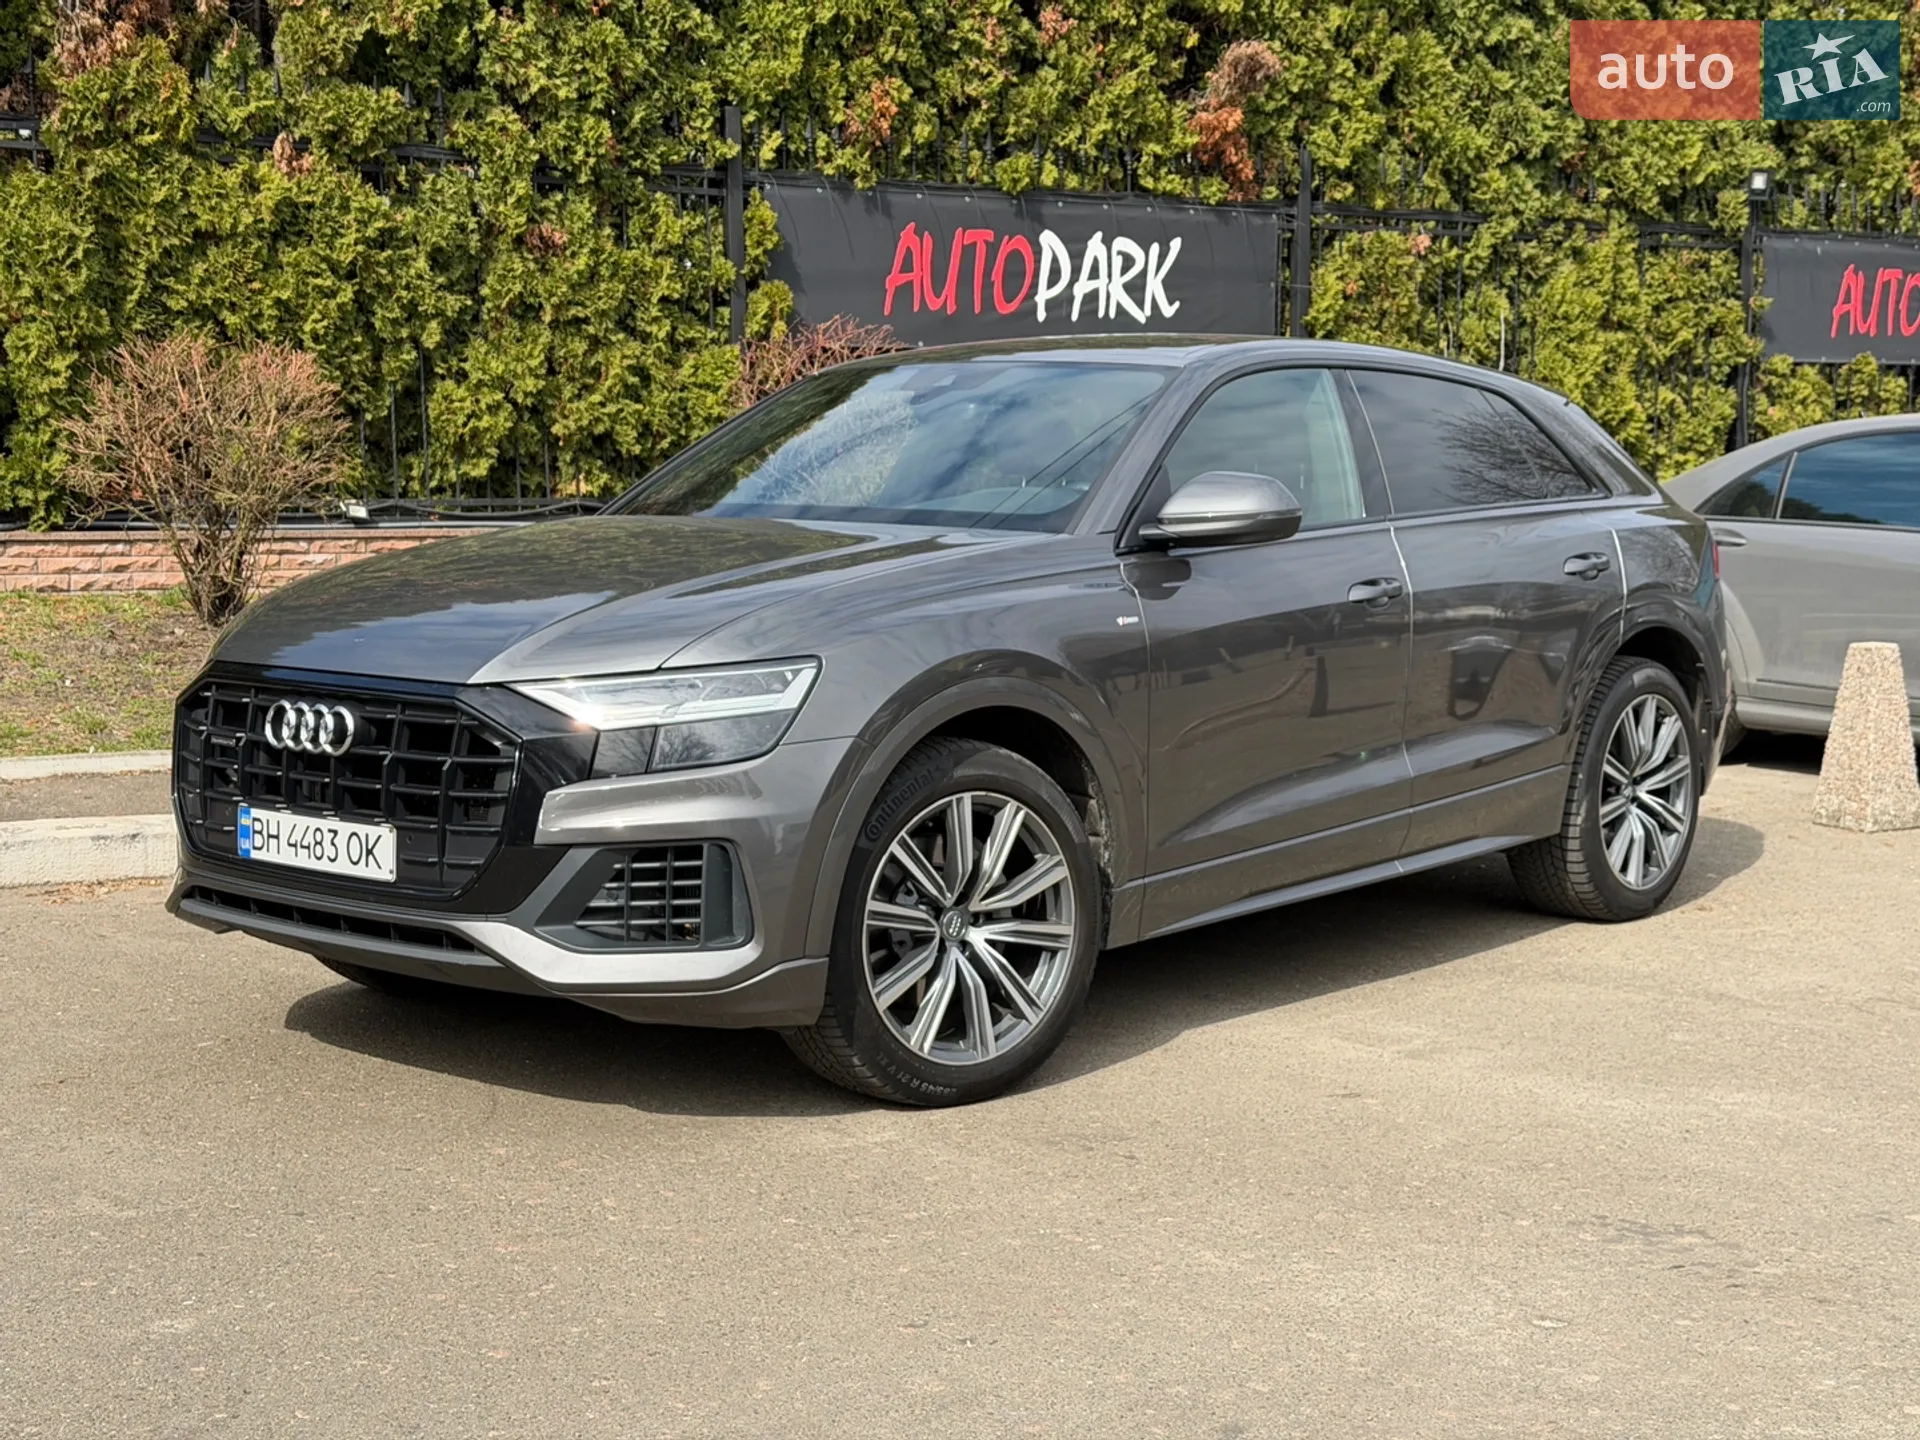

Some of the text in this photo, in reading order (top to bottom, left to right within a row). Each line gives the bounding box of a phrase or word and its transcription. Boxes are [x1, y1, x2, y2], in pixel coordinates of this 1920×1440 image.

[863, 767, 936, 843] Continental
[252, 817, 382, 870] BH 4483 OK
